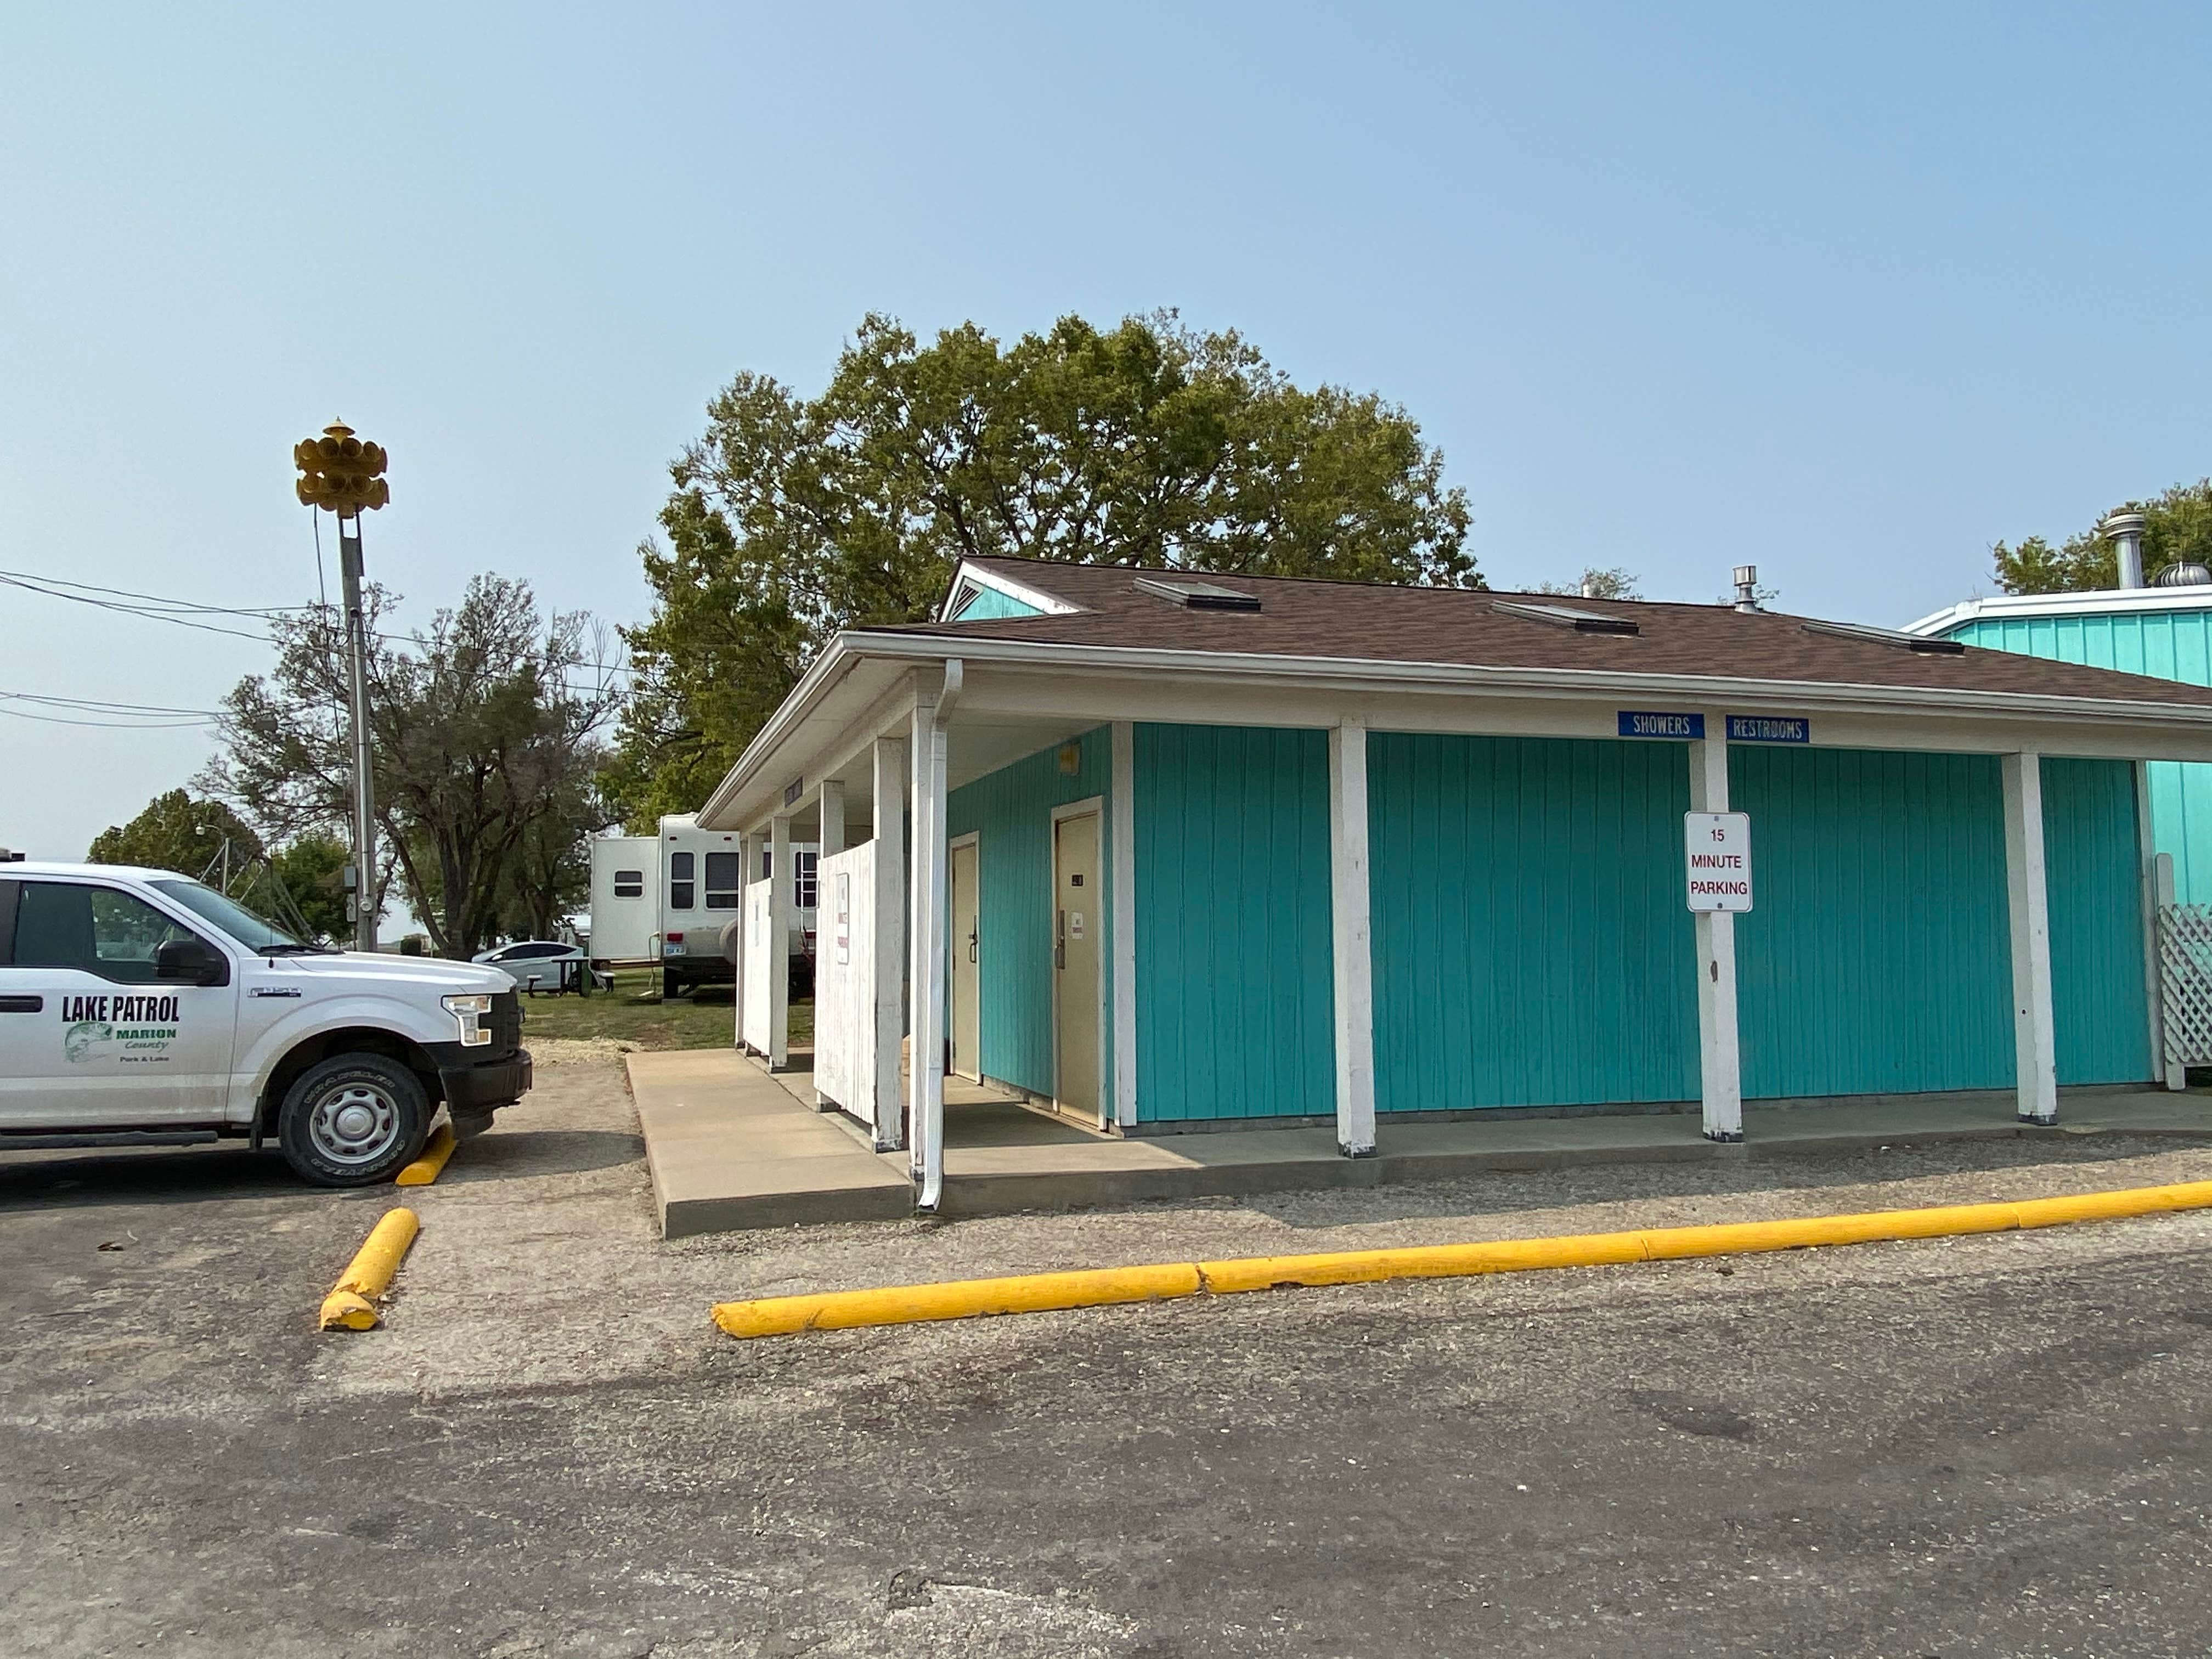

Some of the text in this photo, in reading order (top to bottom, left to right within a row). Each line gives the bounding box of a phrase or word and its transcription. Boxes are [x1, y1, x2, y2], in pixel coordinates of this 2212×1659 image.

[1633, 715, 1690, 735] SHOWERS
[1733, 720, 1803, 739] RESTROOMS
[1711, 829, 1725, 842] 15
[1691, 855, 1742, 868] MINUTE
[1690, 881, 1748, 895] PARKING
[62, 996, 179, 1022] LAKE PATROL
[116, 1029, 177, 1039] MARION
[125, 1041, 170, 1053] County
